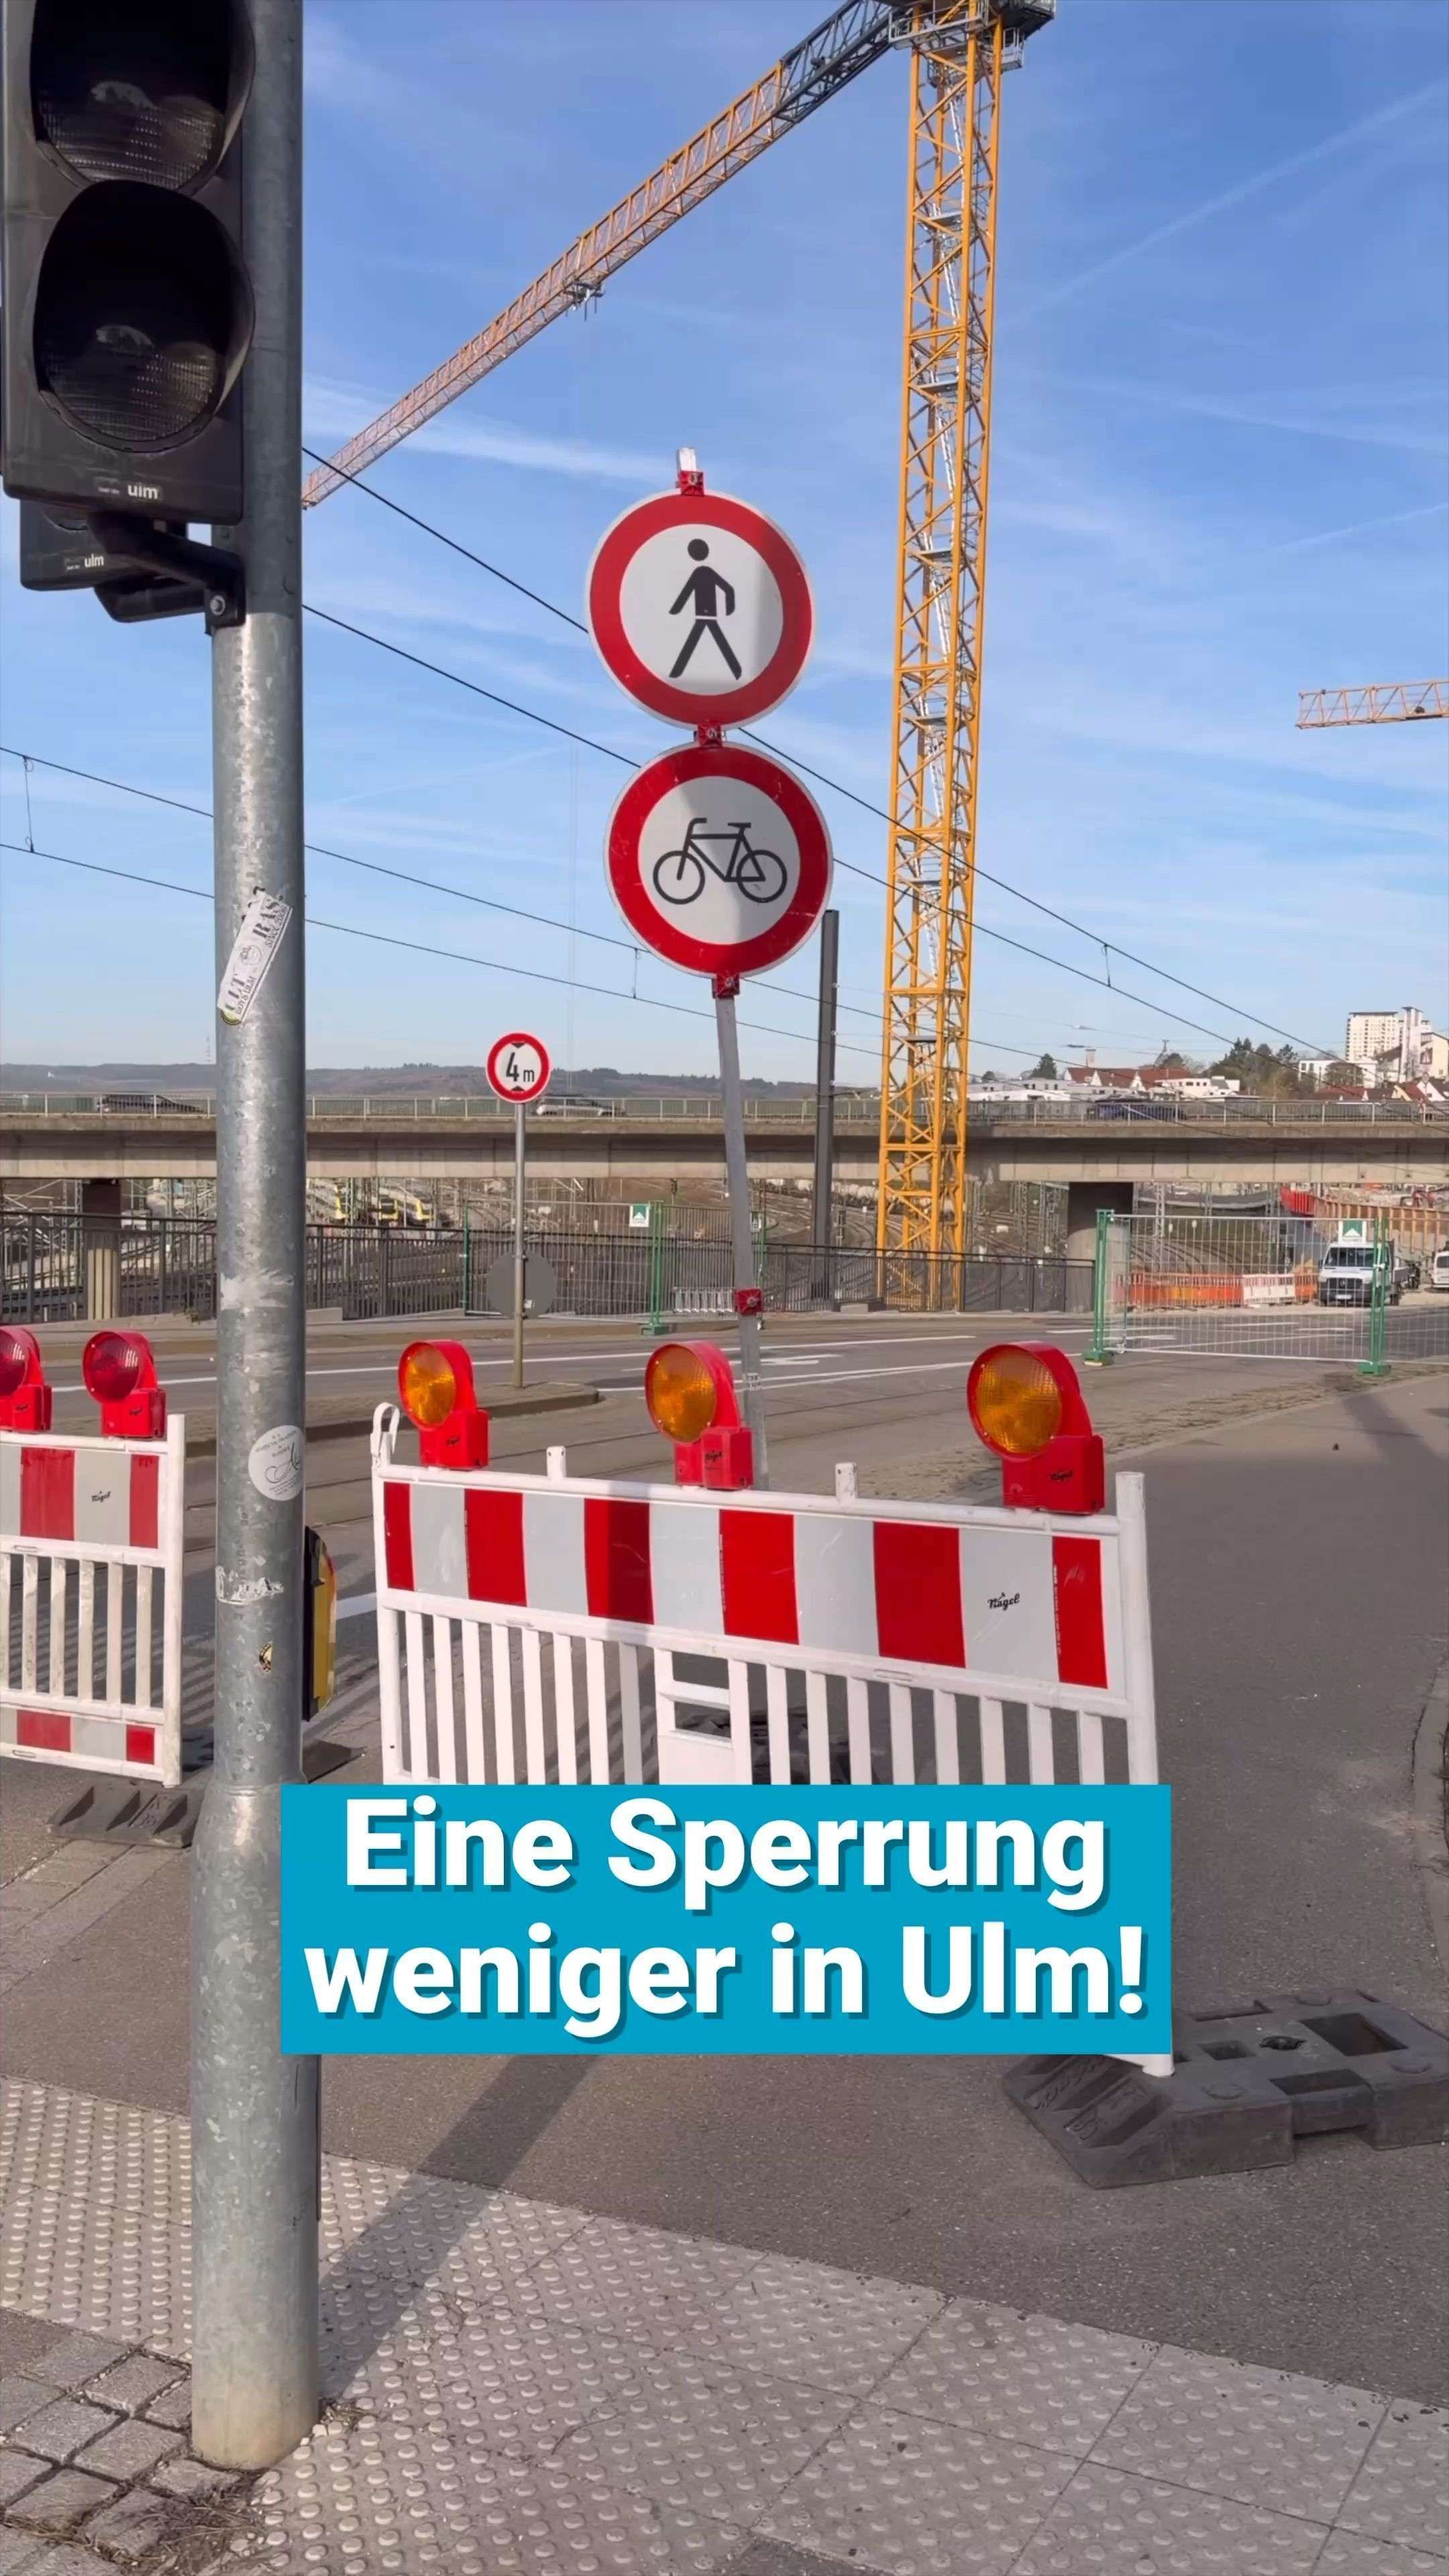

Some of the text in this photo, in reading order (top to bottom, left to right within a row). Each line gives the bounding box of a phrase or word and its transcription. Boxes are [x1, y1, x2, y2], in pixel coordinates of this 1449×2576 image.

[85, 552, 105, 568] ulm
[506, 1052, 535, 1082] 4 m
